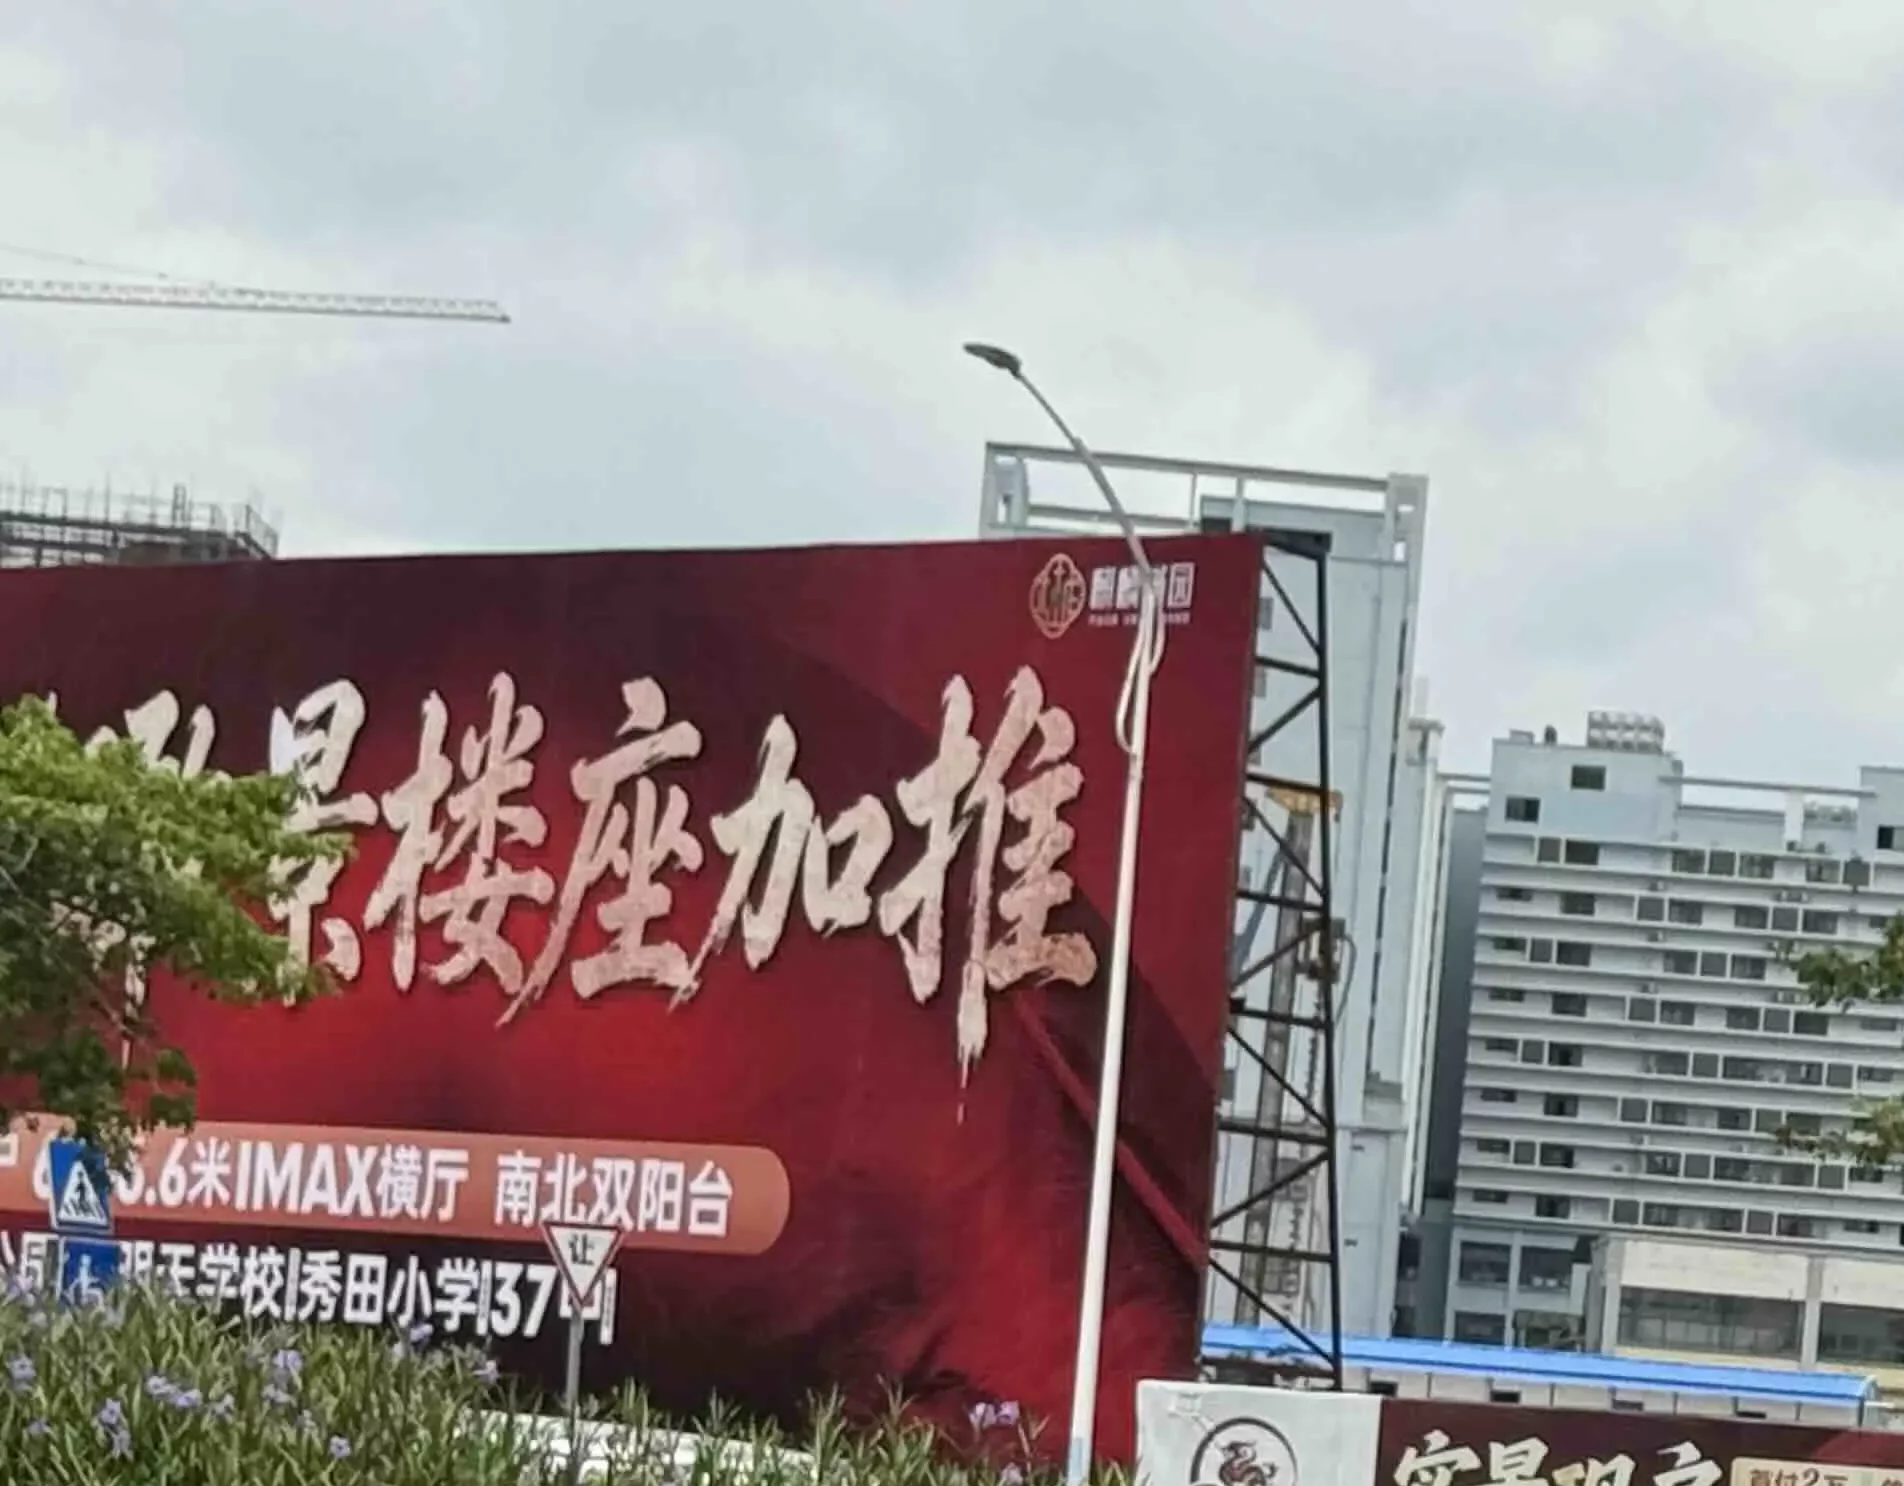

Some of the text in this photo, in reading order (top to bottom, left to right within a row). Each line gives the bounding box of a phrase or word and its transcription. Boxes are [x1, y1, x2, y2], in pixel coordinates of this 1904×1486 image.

[494, 1152, 733, 1238] 南北双阳台
[568, 1233, 596, 1266] 让
